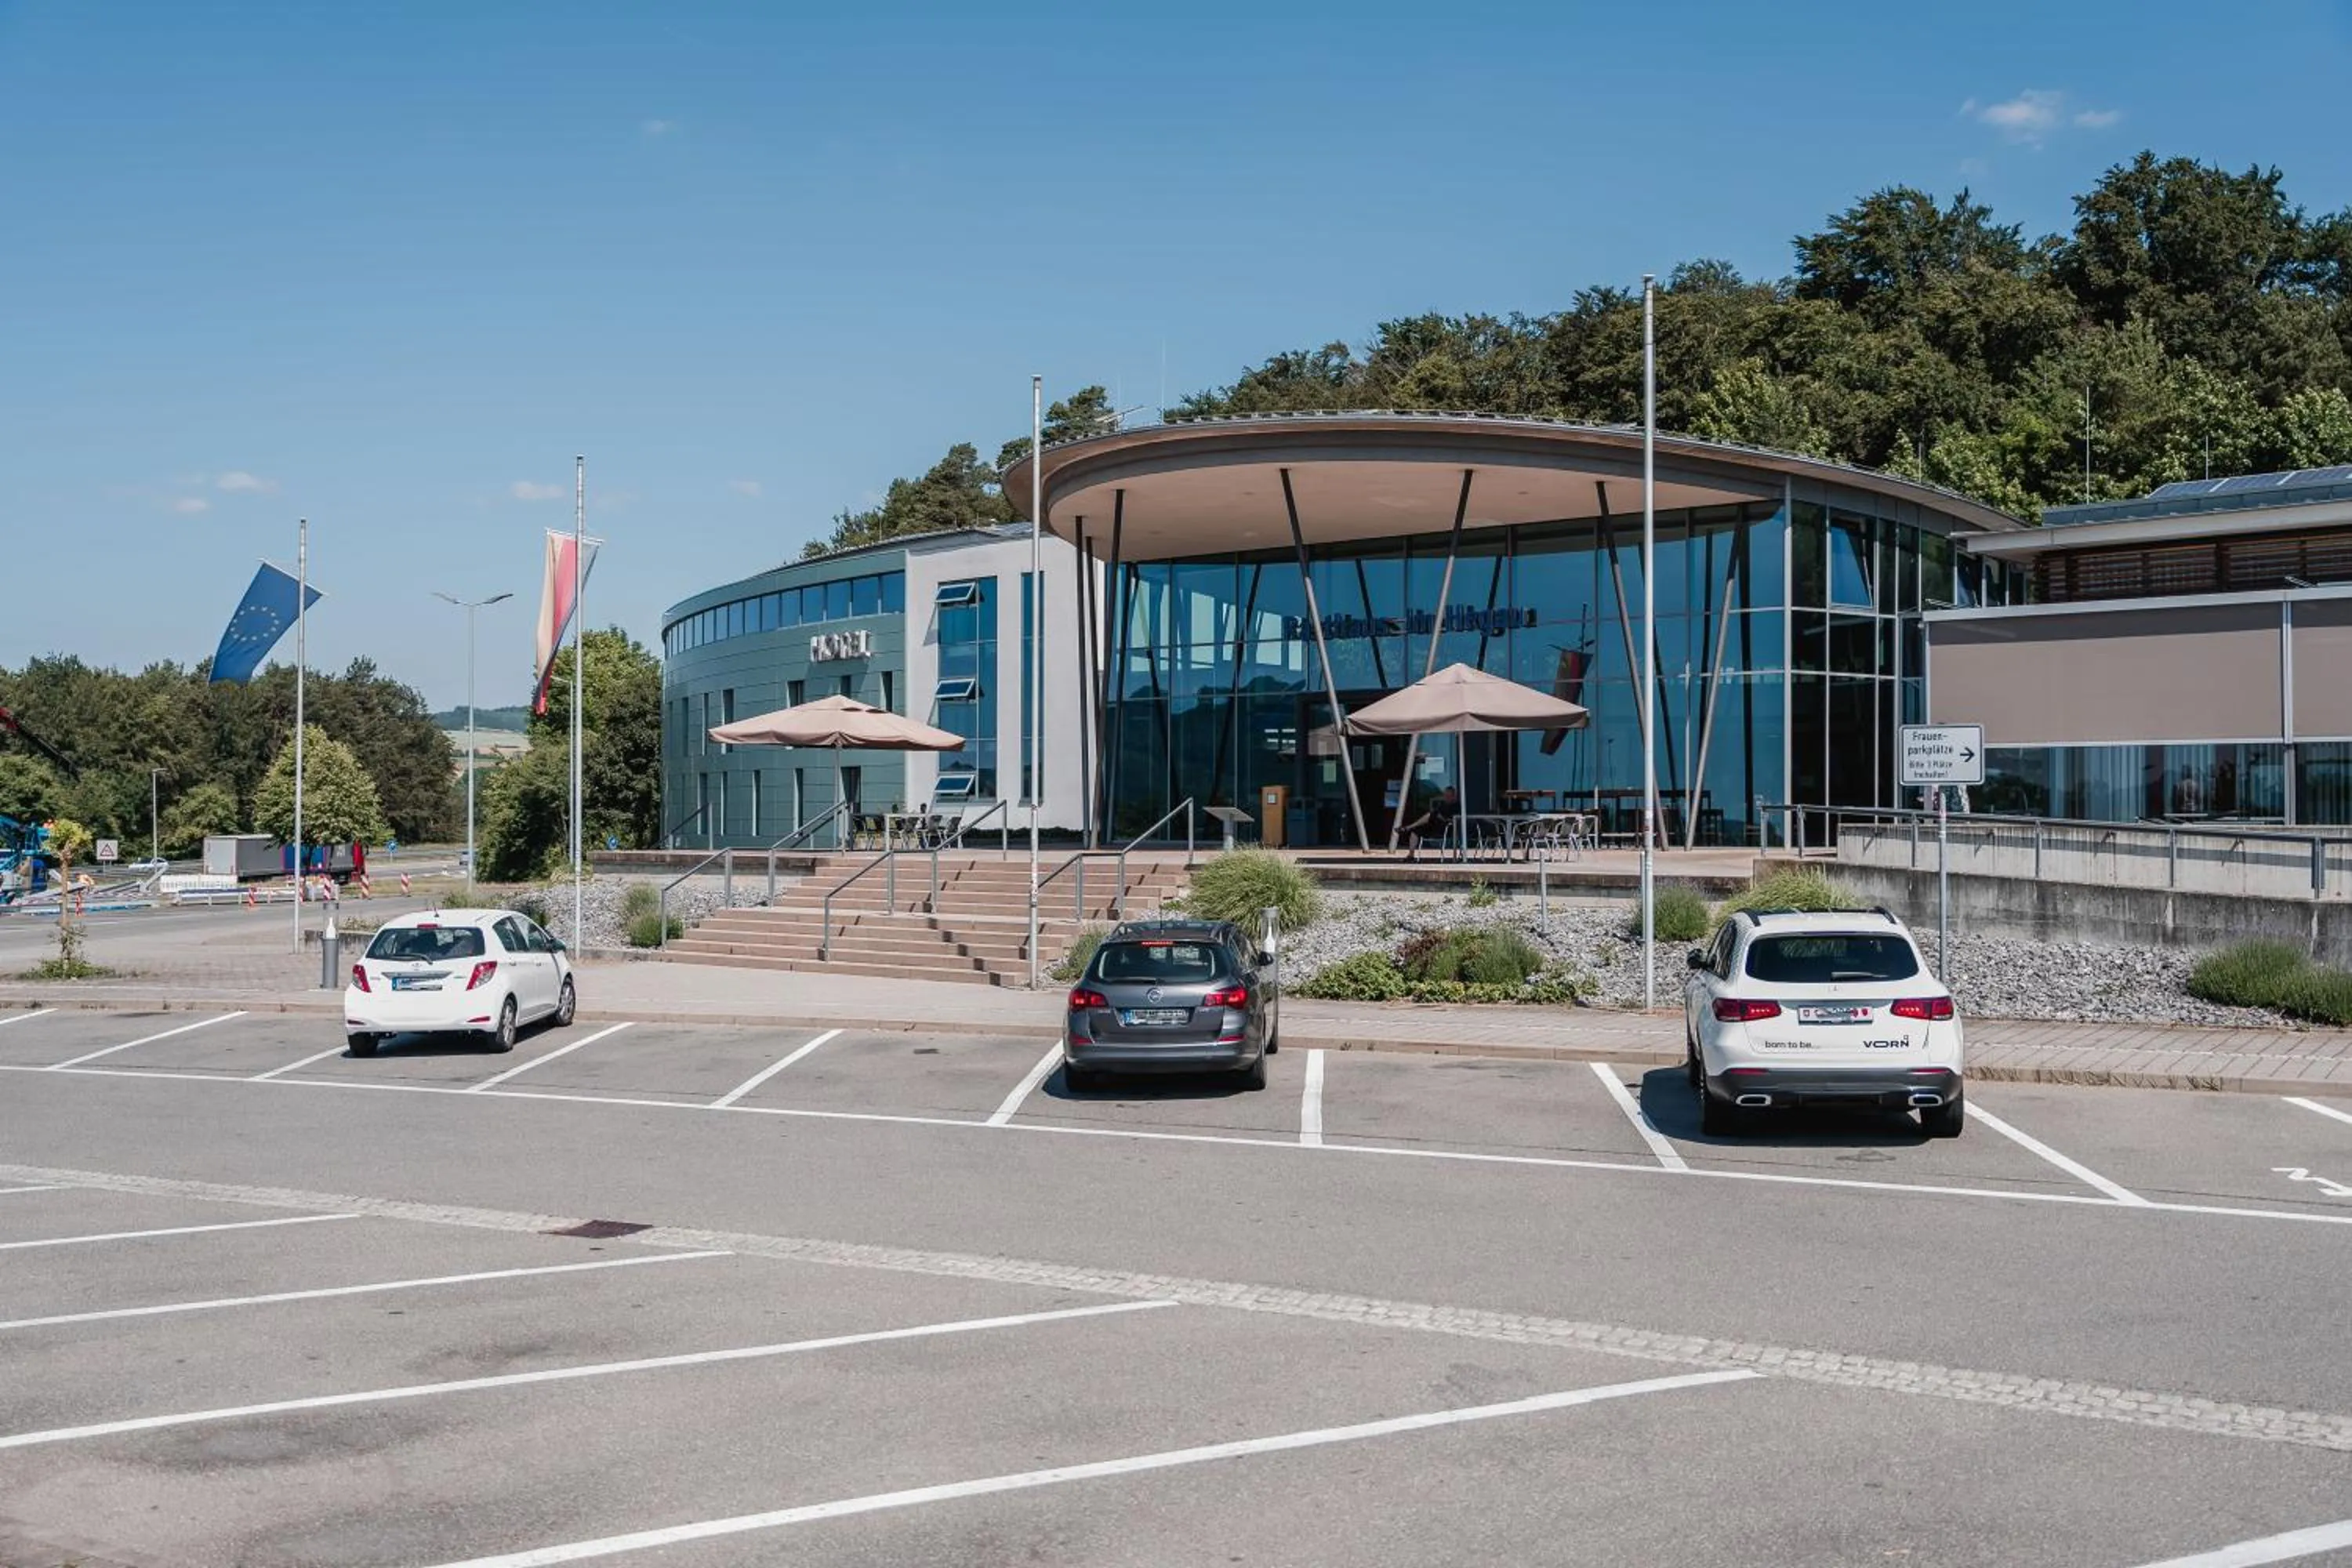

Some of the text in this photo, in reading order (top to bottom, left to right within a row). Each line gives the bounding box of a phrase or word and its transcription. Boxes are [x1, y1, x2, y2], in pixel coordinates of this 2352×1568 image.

[810, 630, 870, 662] HOTEL
[1907, 744, 1953, 756] parkplätze
[1863, 1040, 1909, 1049] VORN
